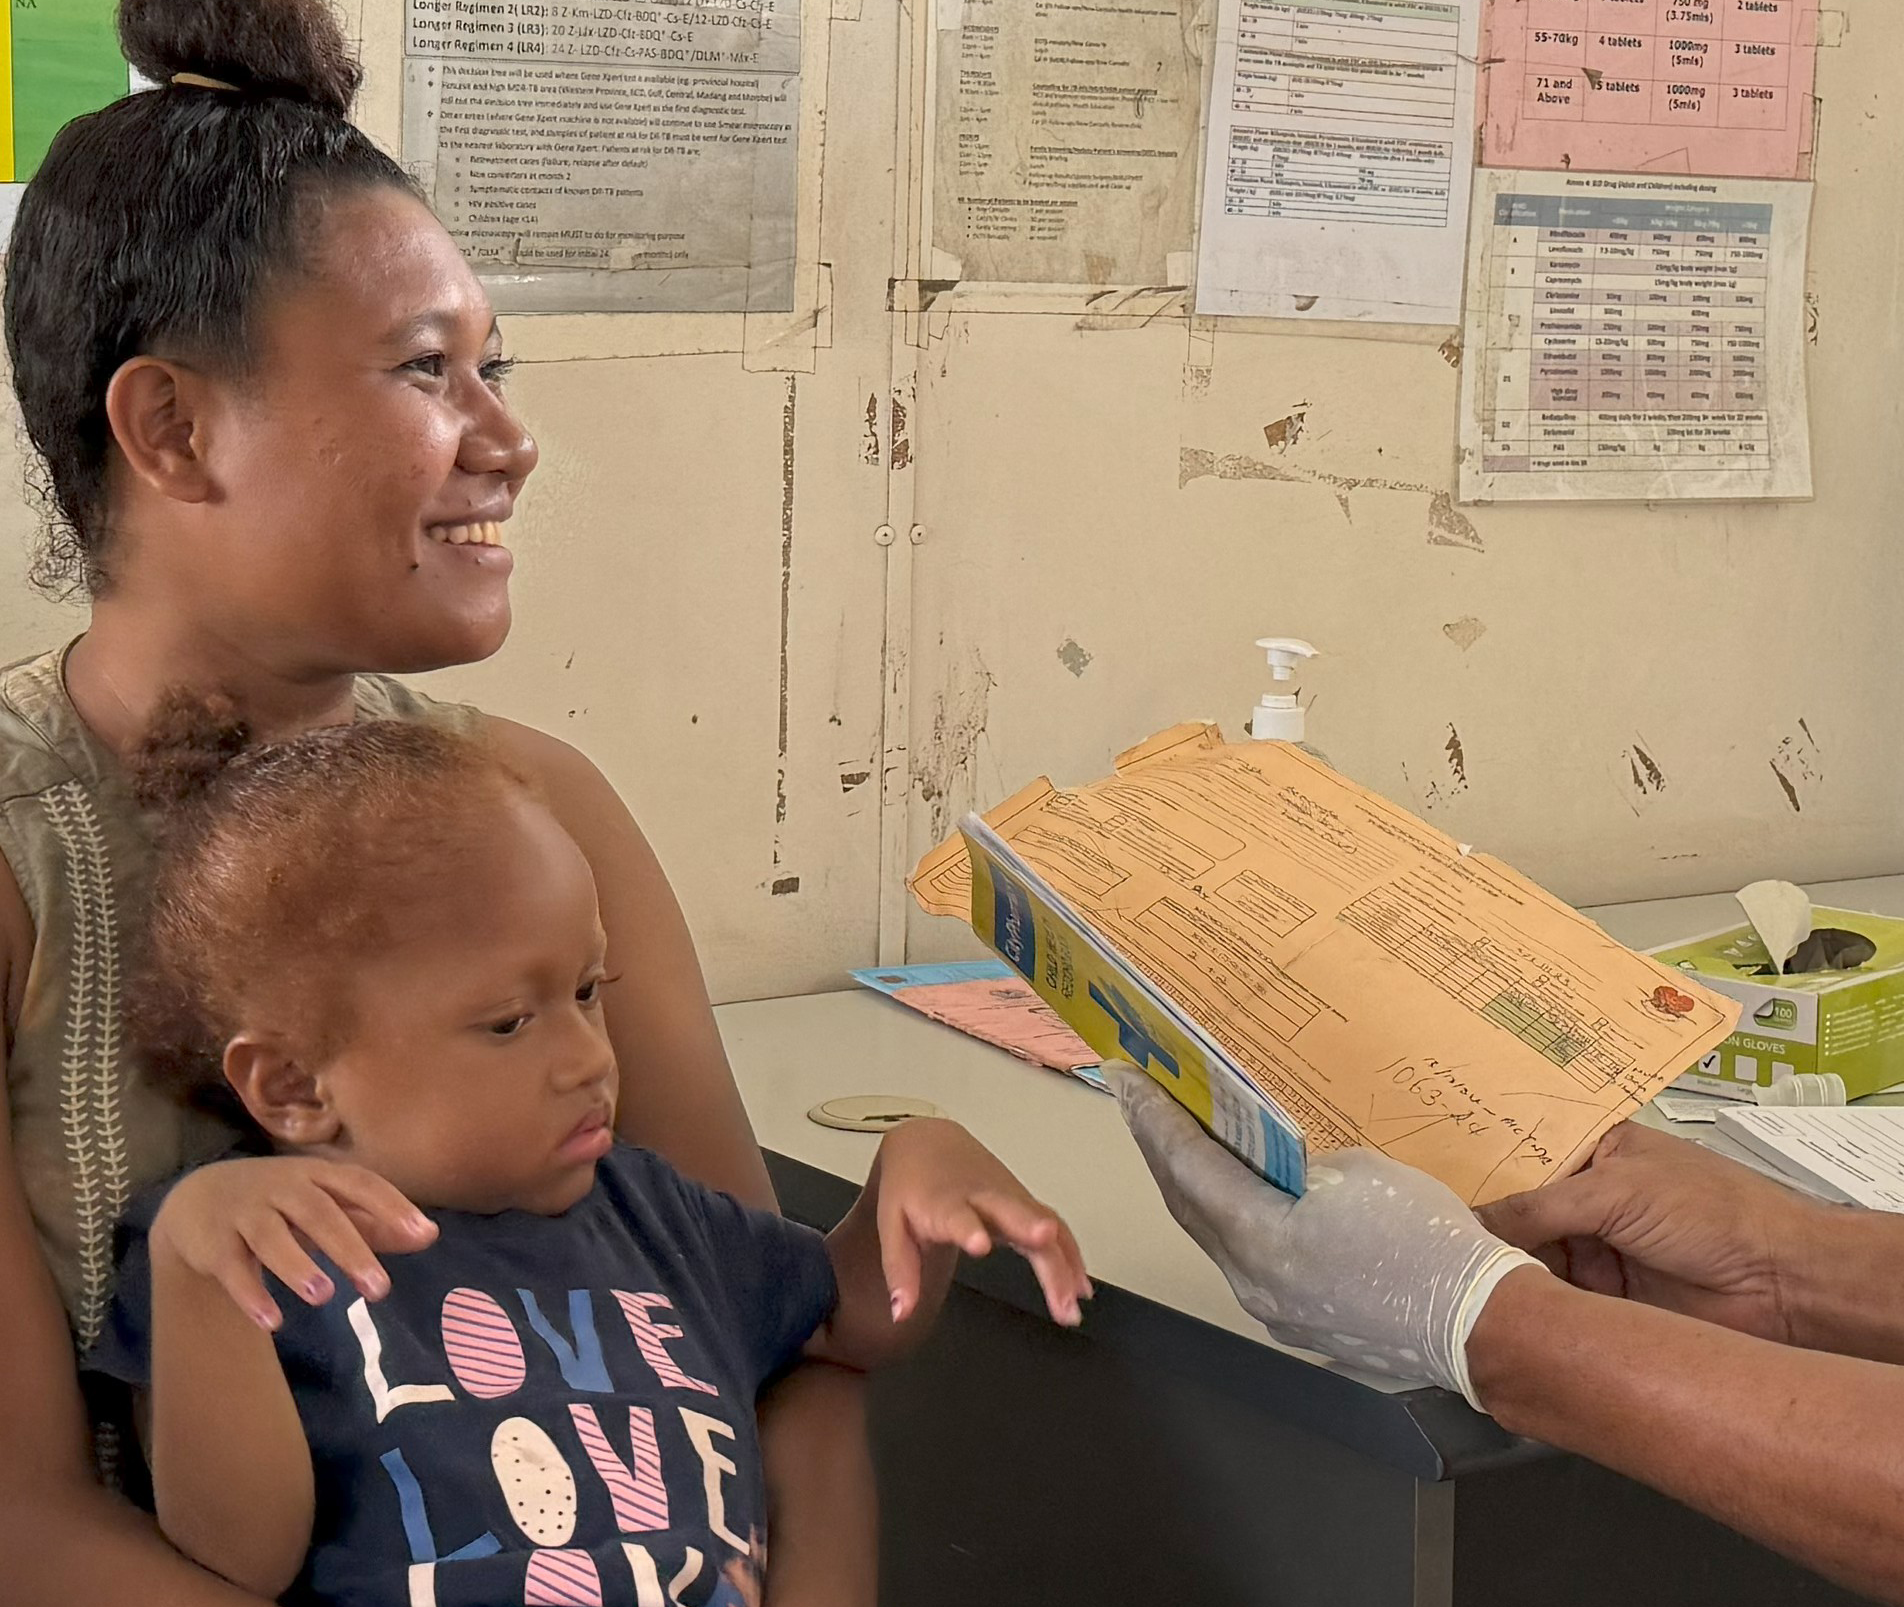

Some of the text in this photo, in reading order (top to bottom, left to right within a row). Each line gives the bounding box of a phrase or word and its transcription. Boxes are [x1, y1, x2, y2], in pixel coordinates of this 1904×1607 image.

[412, 35, 549, 56] Longer Regimen 4 (LR4):
[1536, 77, 1573, 90] 71 and
[1536, 91, 1571, 105] Above
[1774, 1006, 1792, 1019] 100
[1742, 1037, 1786, 1055] GLOVES
[346, 1287, 719, 1424] LOVE
[379, 1403, 751, 1565] LOVE
